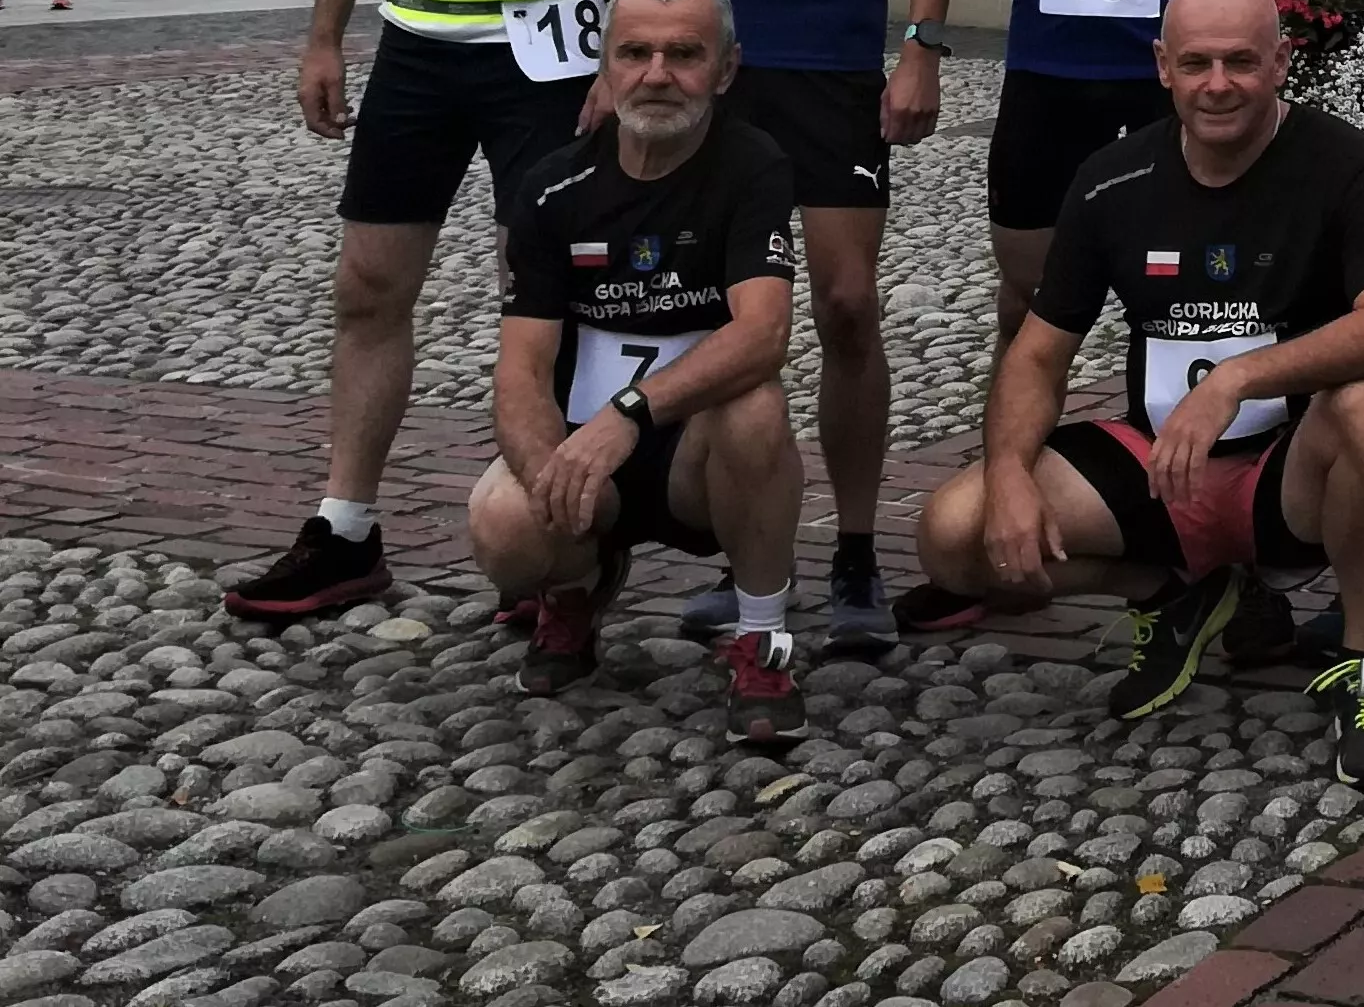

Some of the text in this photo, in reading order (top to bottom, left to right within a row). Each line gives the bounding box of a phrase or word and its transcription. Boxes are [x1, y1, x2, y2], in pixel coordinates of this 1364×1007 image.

[536, 0, 601, 63] 18
[595, 271, 682, 300] GORLCKA
[1169, 301, 1260, 320] GORLICKA
[621, 344, 660, 389] 7
